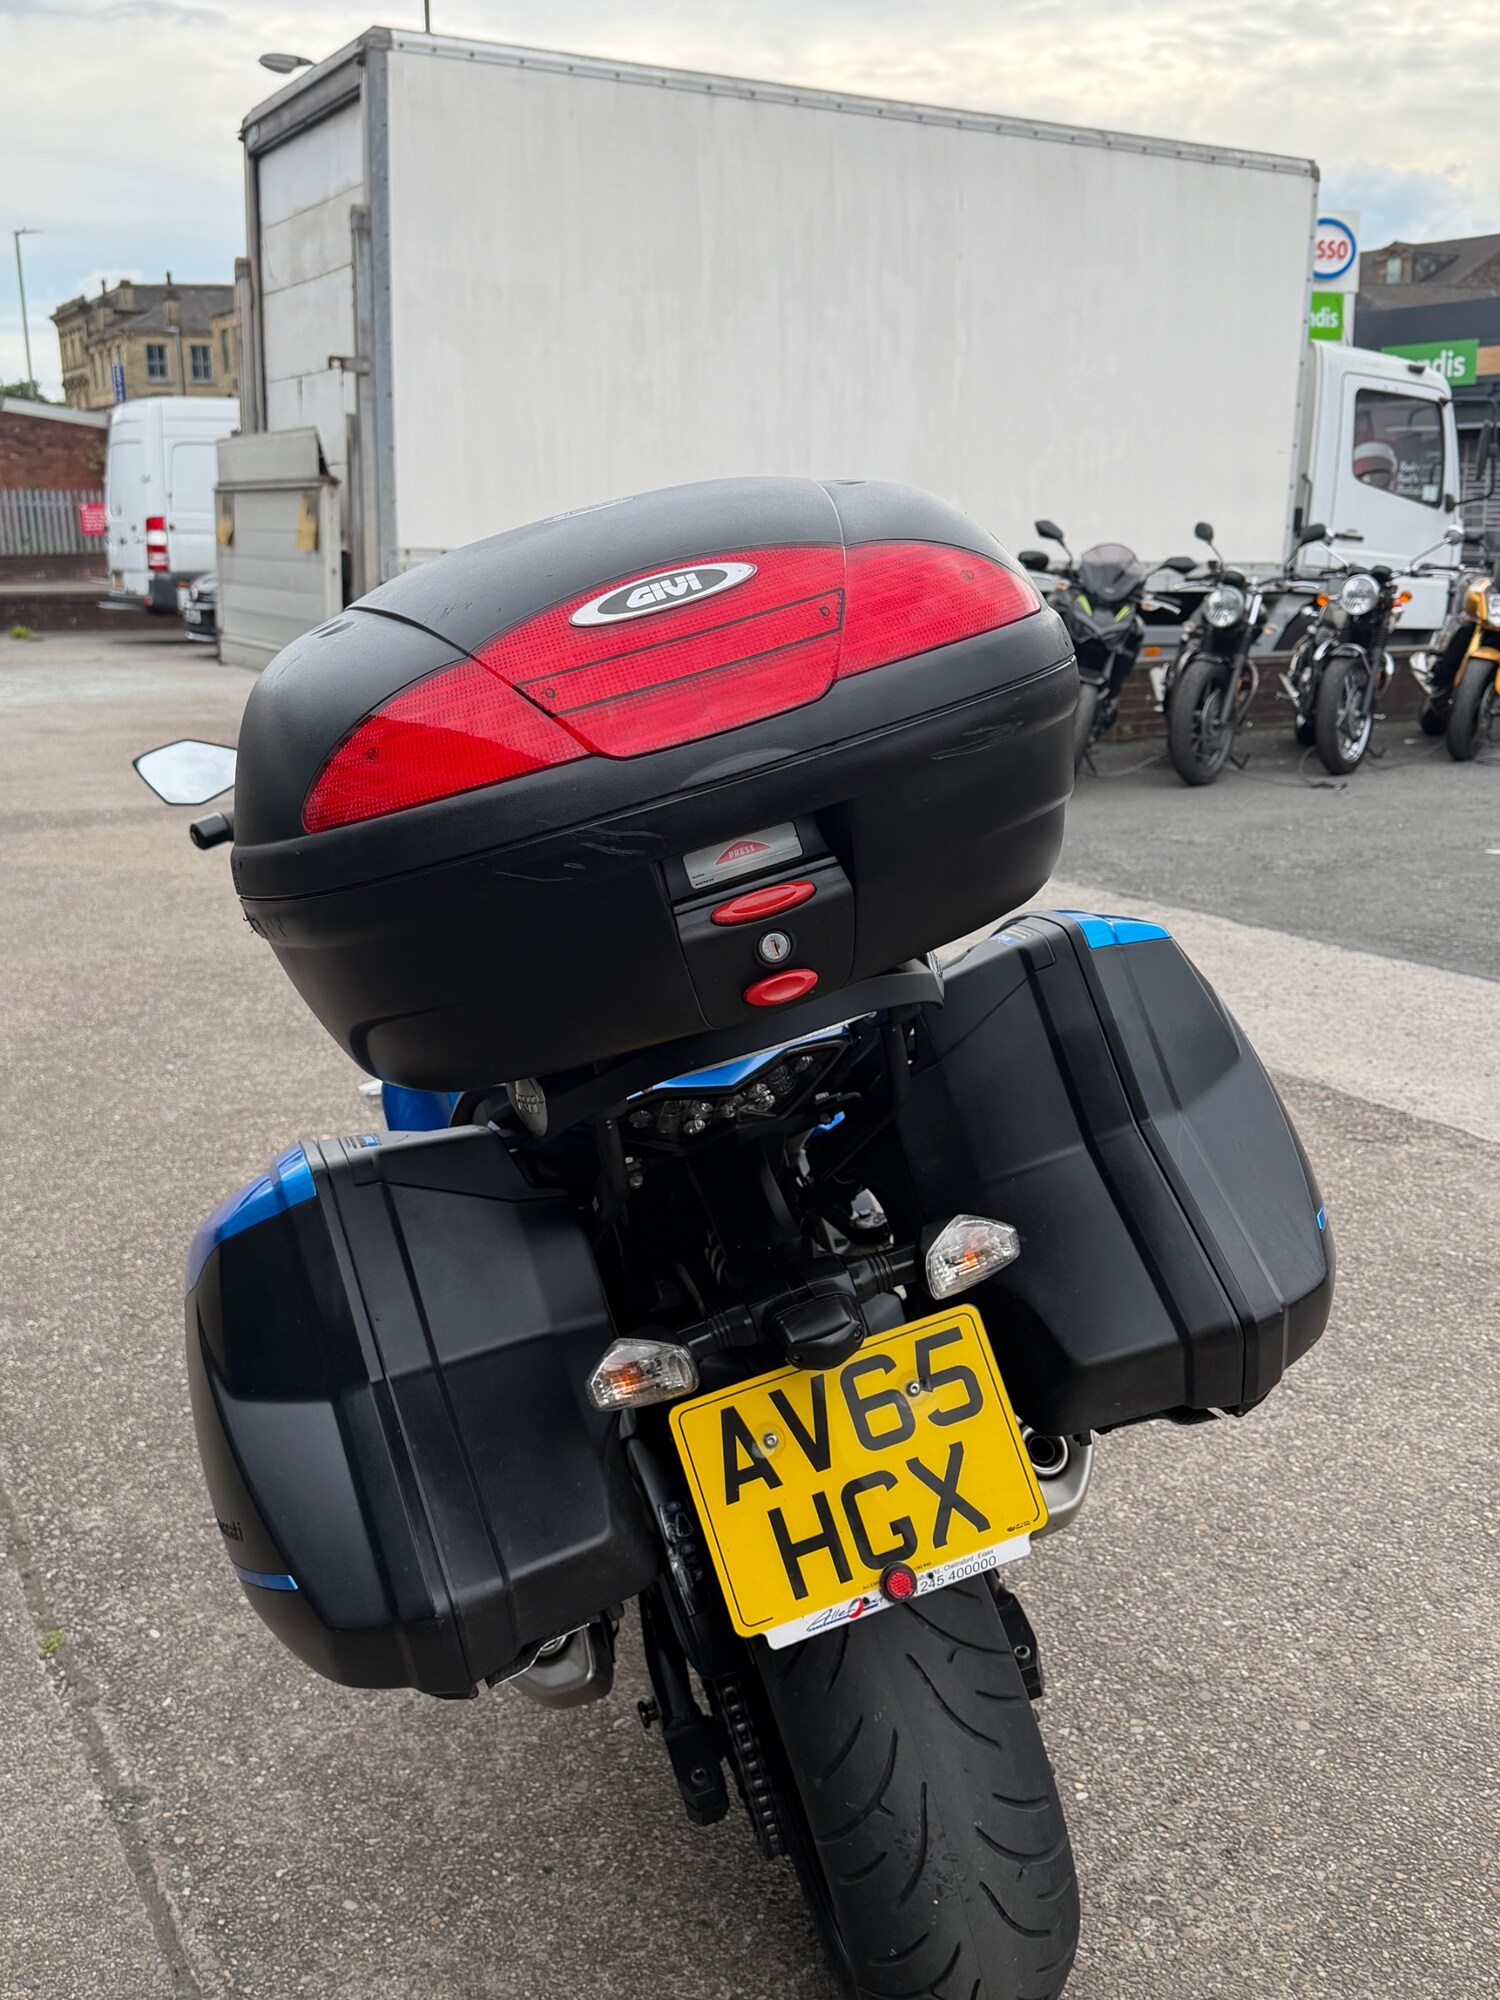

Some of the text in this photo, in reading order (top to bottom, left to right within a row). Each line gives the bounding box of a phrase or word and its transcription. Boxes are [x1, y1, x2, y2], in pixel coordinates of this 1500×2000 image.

[1316, 239, 1349, 260] SSO
[626, 572, 703, 609] GIVI
[728, 844, 755, 859] PRESS
[719, 1326, 985, 1506] AV65
[766, 1441, 992, 1601] HGX
[977, 1549, 994, 1559] Essex
[948, 1555, 997, 1581] 400000
